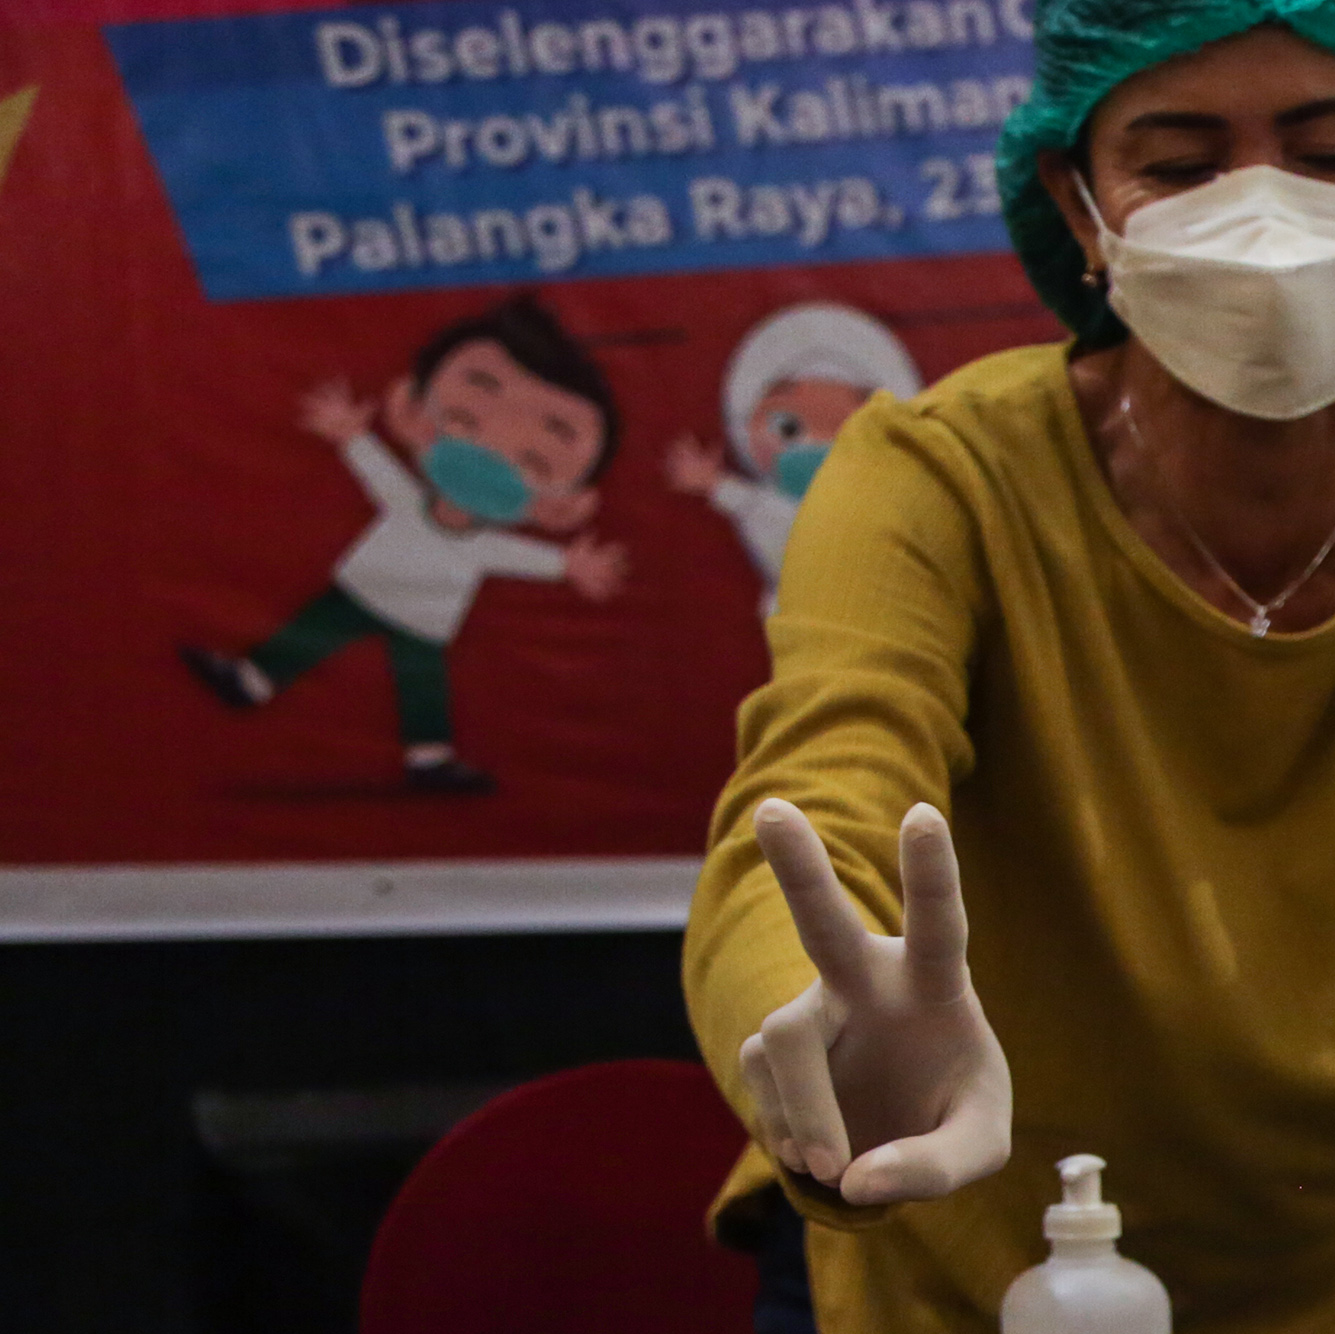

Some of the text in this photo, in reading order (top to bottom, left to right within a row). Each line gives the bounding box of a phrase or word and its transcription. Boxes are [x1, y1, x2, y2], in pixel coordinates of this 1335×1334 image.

[383, 87, 715, 172] Provinsi
[288, 187, 672, 277] Palangka
[688, 177, 904, 248] Raya,
